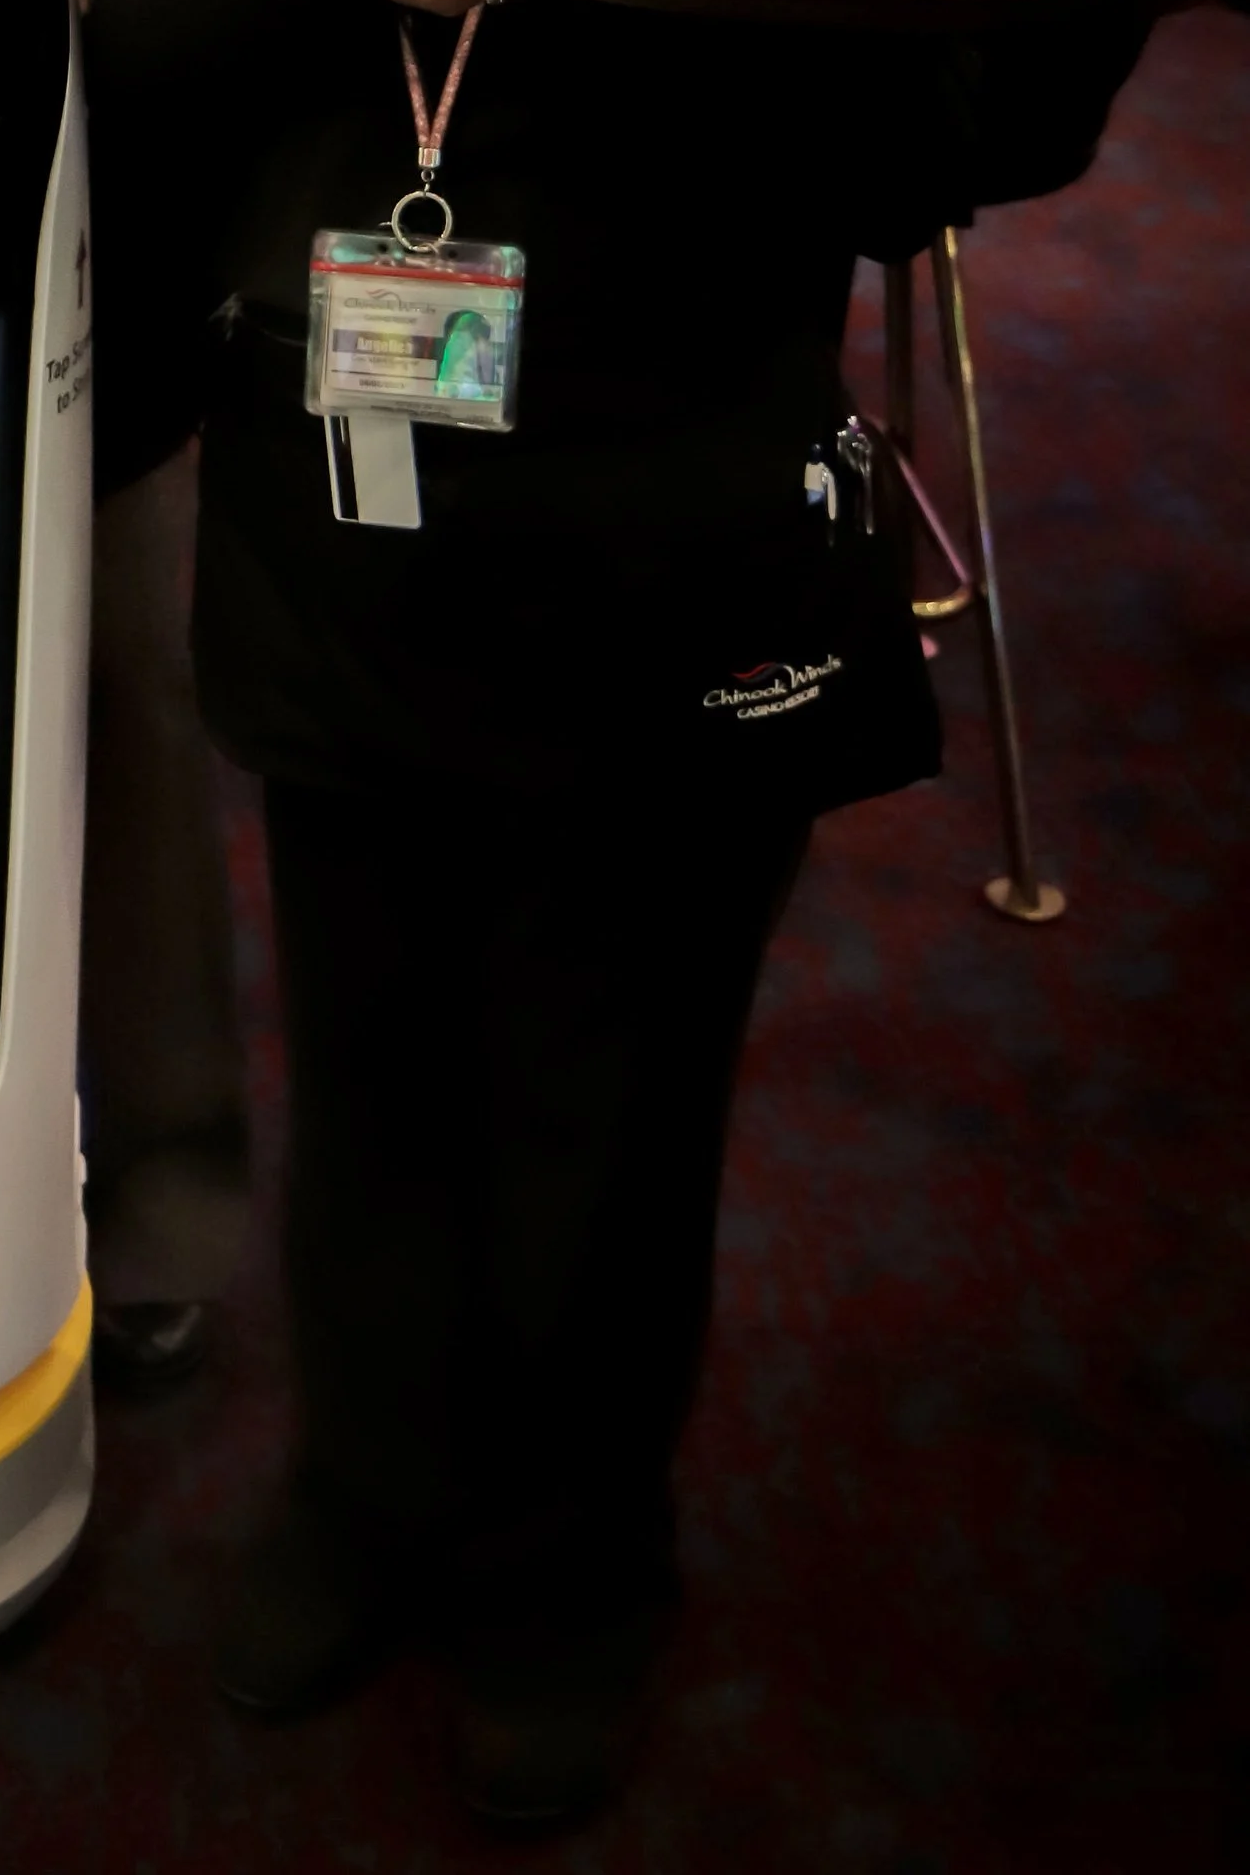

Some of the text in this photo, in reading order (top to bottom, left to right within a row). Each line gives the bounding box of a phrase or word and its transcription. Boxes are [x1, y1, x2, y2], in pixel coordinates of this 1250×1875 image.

[46, 354, 70, 383] Tap
[703, 653, 842, 707] Chinook Winds
[737, 701, 784, 719] CASINO
